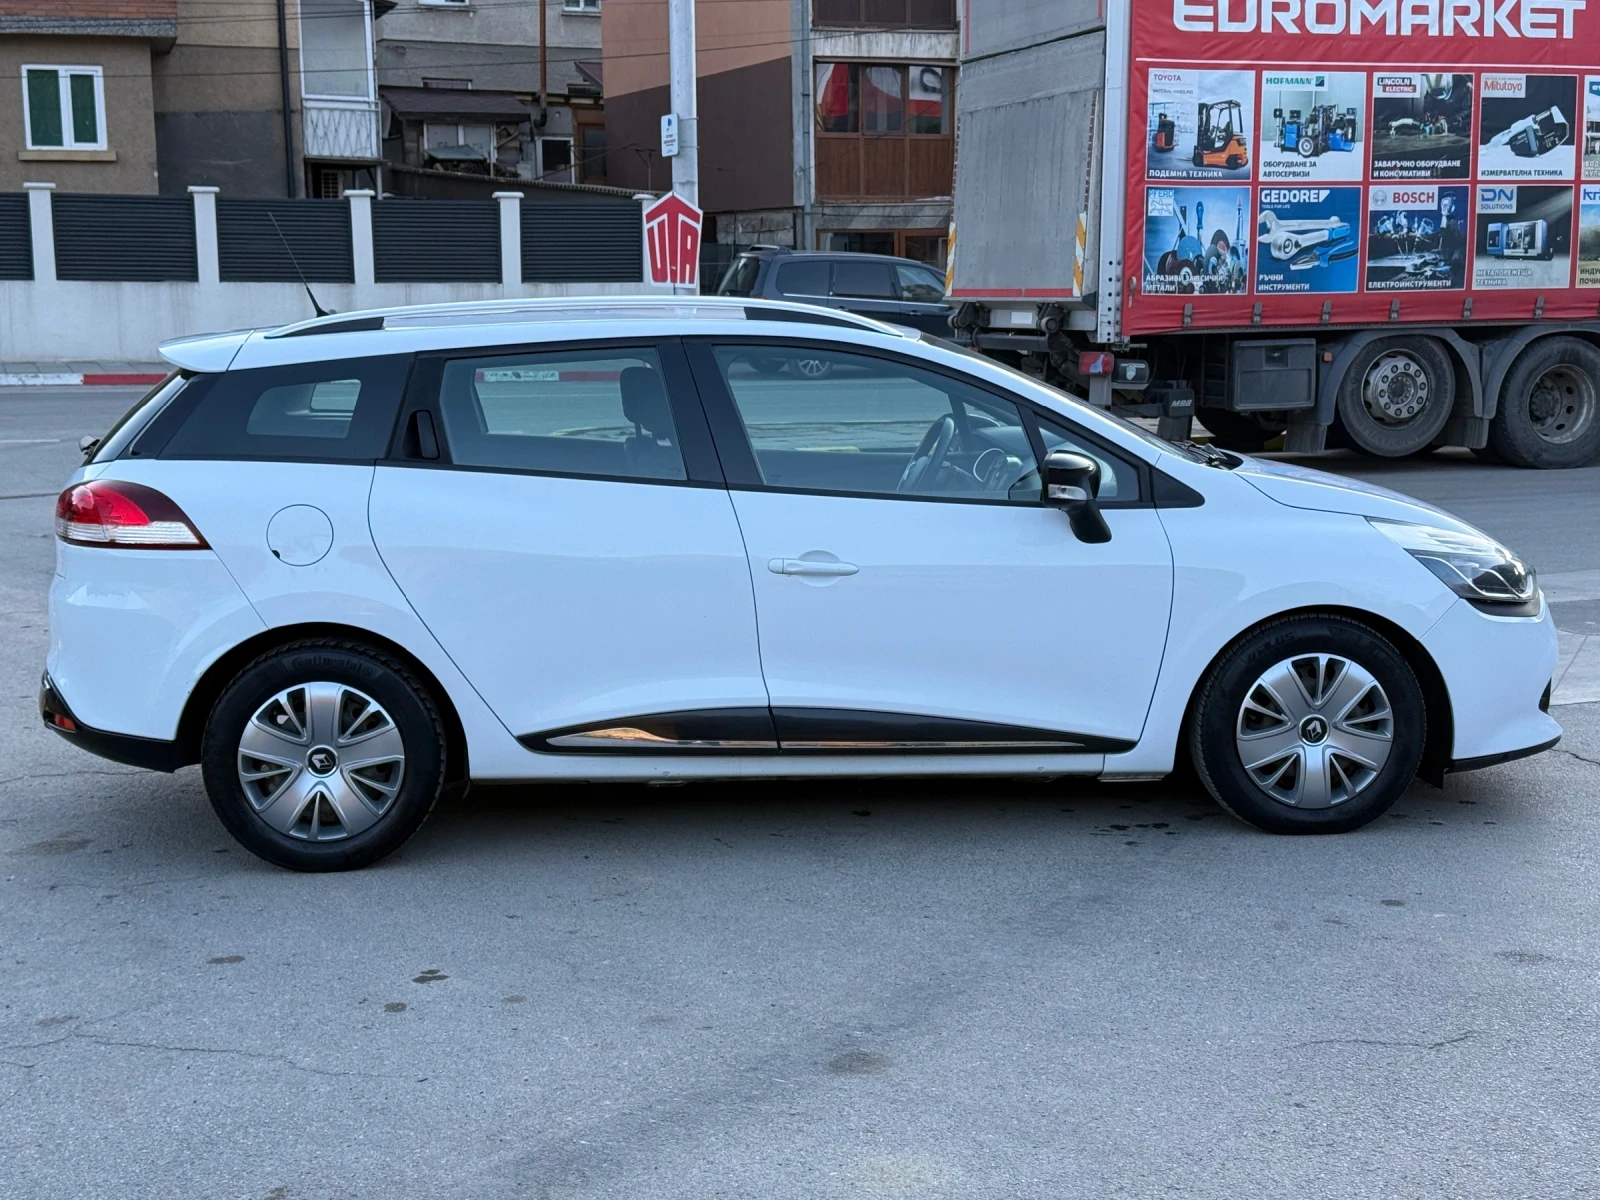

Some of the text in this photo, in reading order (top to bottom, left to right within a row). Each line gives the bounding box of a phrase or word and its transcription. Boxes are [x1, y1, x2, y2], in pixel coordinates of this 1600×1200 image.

[1173, 0, 1587, 39] EUROMARKET
[1153, 74, 1182, 82] TOYOTA
[1265, 77, 1312, 85] HOFMANN
[1378, 78, 1411, 86] LINCOLN
[1484, 80, 1523, 93] Mitutoyo
[1263, 161, 1307, 169] ОБОРУДВАНЕ
[1373, 159, 1461, 168] ЗАВАРЪЧНО ОБОРУДВАНЕ
[1149, 169, 1223, 178] ПОДЕМНА ТЕХНИКА
[1262, 170, 1310, 178] АВТОСЕРВИЗИ
[1380, 170, 1431, 178] КОНСУМАТИВИ
[1148, 189, 1175, 198] PFERD
[1261, 189, 1319, 203] GEDORE
[1480, 188, 1514, 202] DN
[1392, 192, 1435, 204] BOSCH
[1476, 268, 1532, 277] МЕТАЛОРЕЖЕЩА
[1145, 274, 1184, 282] АБРАЗИВИ
[1194, 274, 1223, 282] ВСИЧКИ
[1476, 278, 1507, 286] ТЕХНИКА
[1145, 284, 1176, 292] МЕТАЛИ
[1258, 283, 1310, 291] ИНСТРУМЕНТИ
[1368, 279, 1452, 289] ЕЛЕКТРОИНСТРУМЕНТИ
[1171, 399, 1193, 407] MBB
